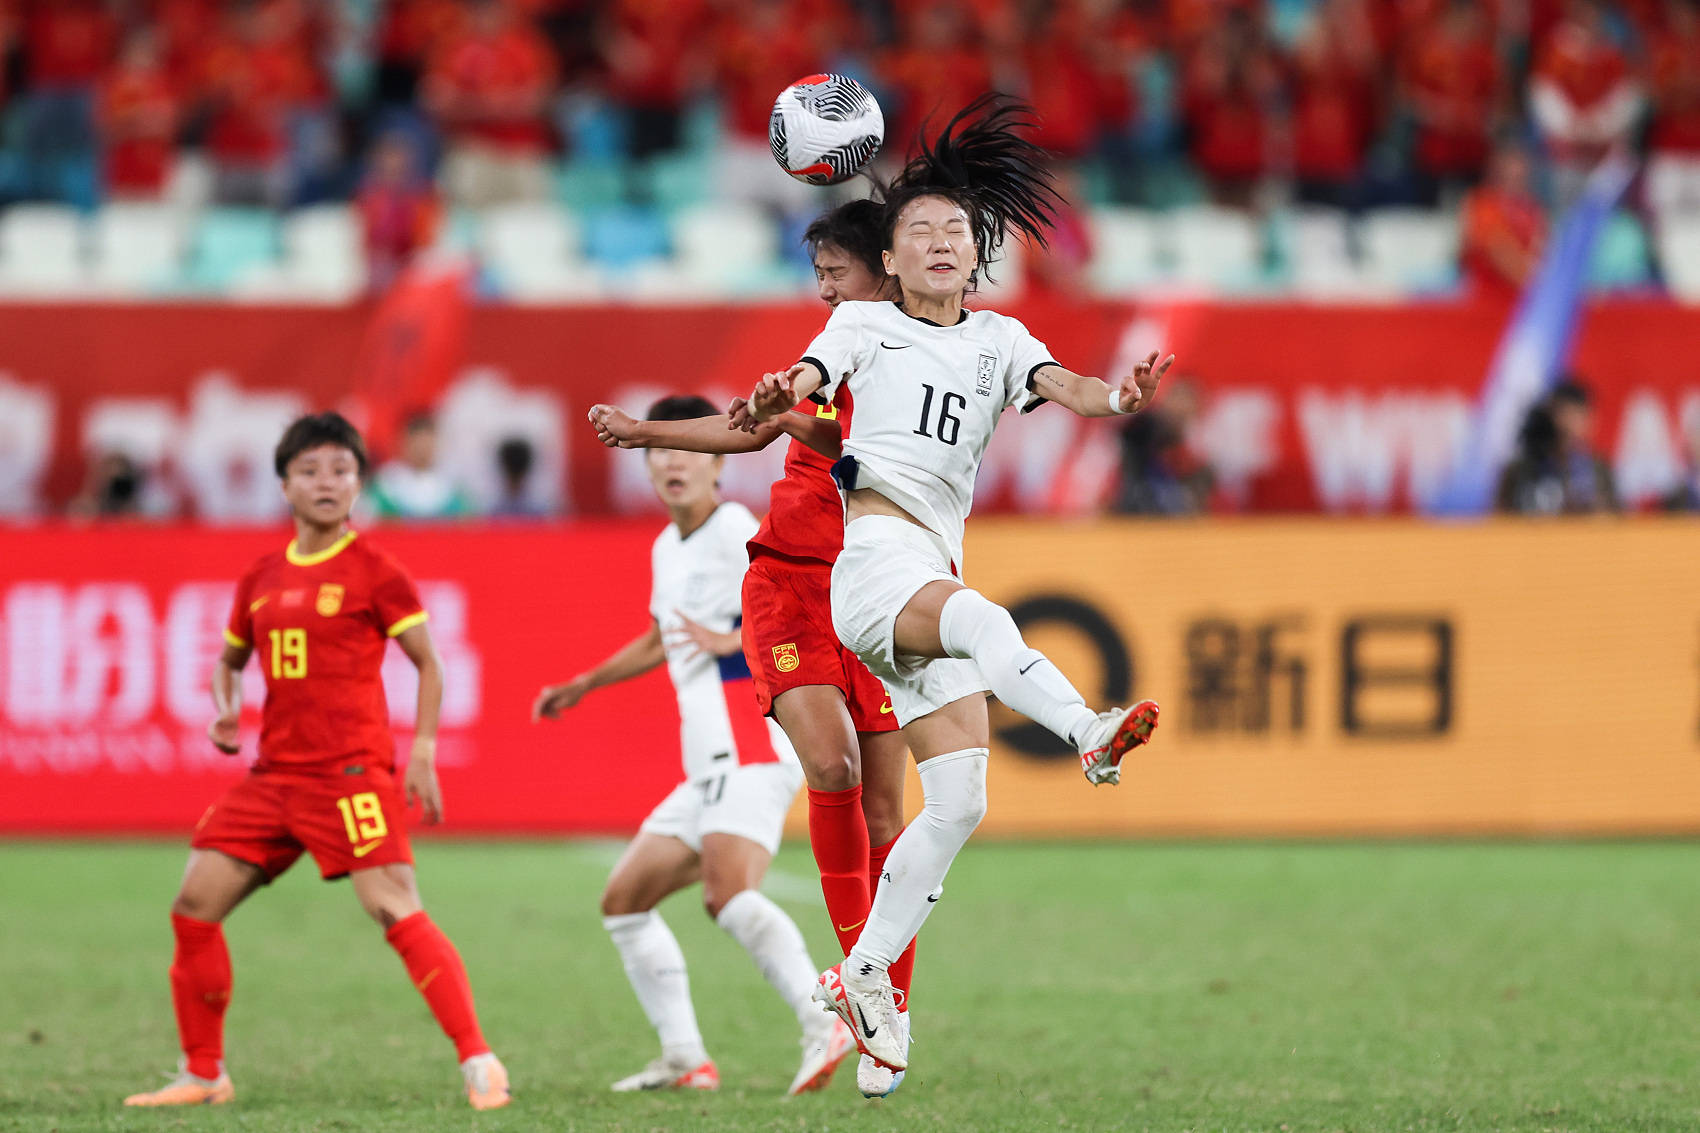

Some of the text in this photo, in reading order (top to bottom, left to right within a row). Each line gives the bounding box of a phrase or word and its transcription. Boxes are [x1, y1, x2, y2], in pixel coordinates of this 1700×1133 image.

[912, 383, 967, 446] 16
[268, 628, 308, 680] 19
[336, 792, 388, 844] 19
